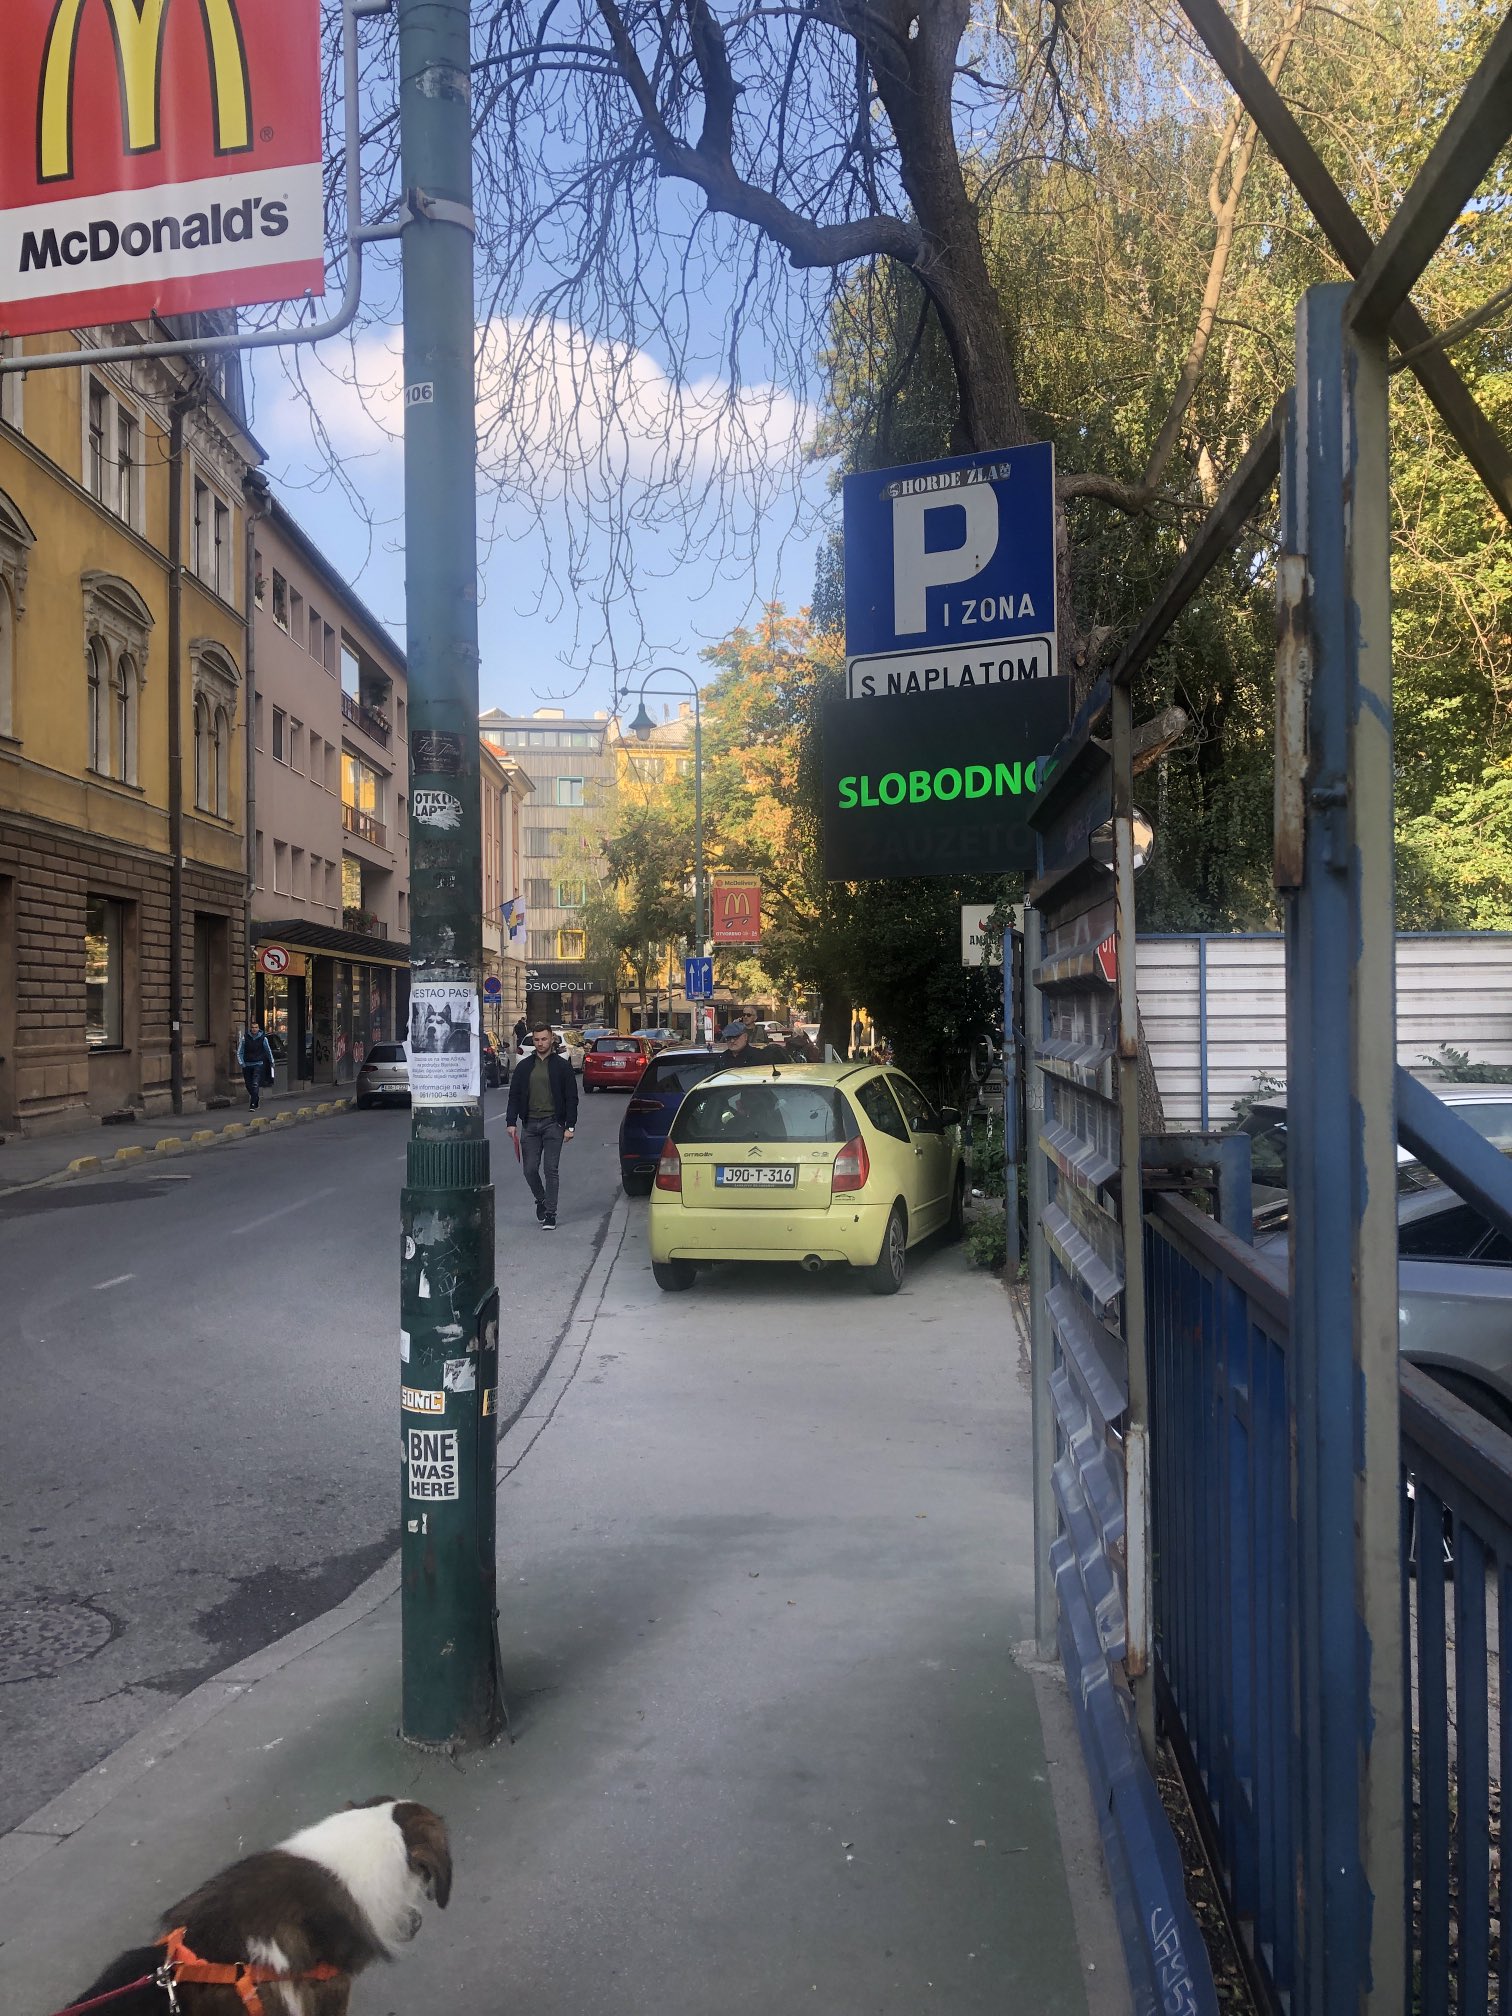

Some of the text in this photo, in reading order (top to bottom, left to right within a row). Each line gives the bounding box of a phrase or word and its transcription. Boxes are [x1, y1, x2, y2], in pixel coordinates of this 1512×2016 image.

[19, 197, 289, 272] McDonald's
[406, 385, 432, 403] 106
[902, 465, 998, 496] HORDE ZLA
[893, 482, 999, 636] P
[961, 593, 1035, 625] ZONA
[861, 657, 1038, 698] S NAPLATOM
[449, 989, 471, 998] PAS!
[726, 1169, 792, 1182] J90-T-316
[410, 1433, 454, 1462] BNE
[411, 1464, 454, 1479] WAS
[411, 1482, 455, 1497] HERE
